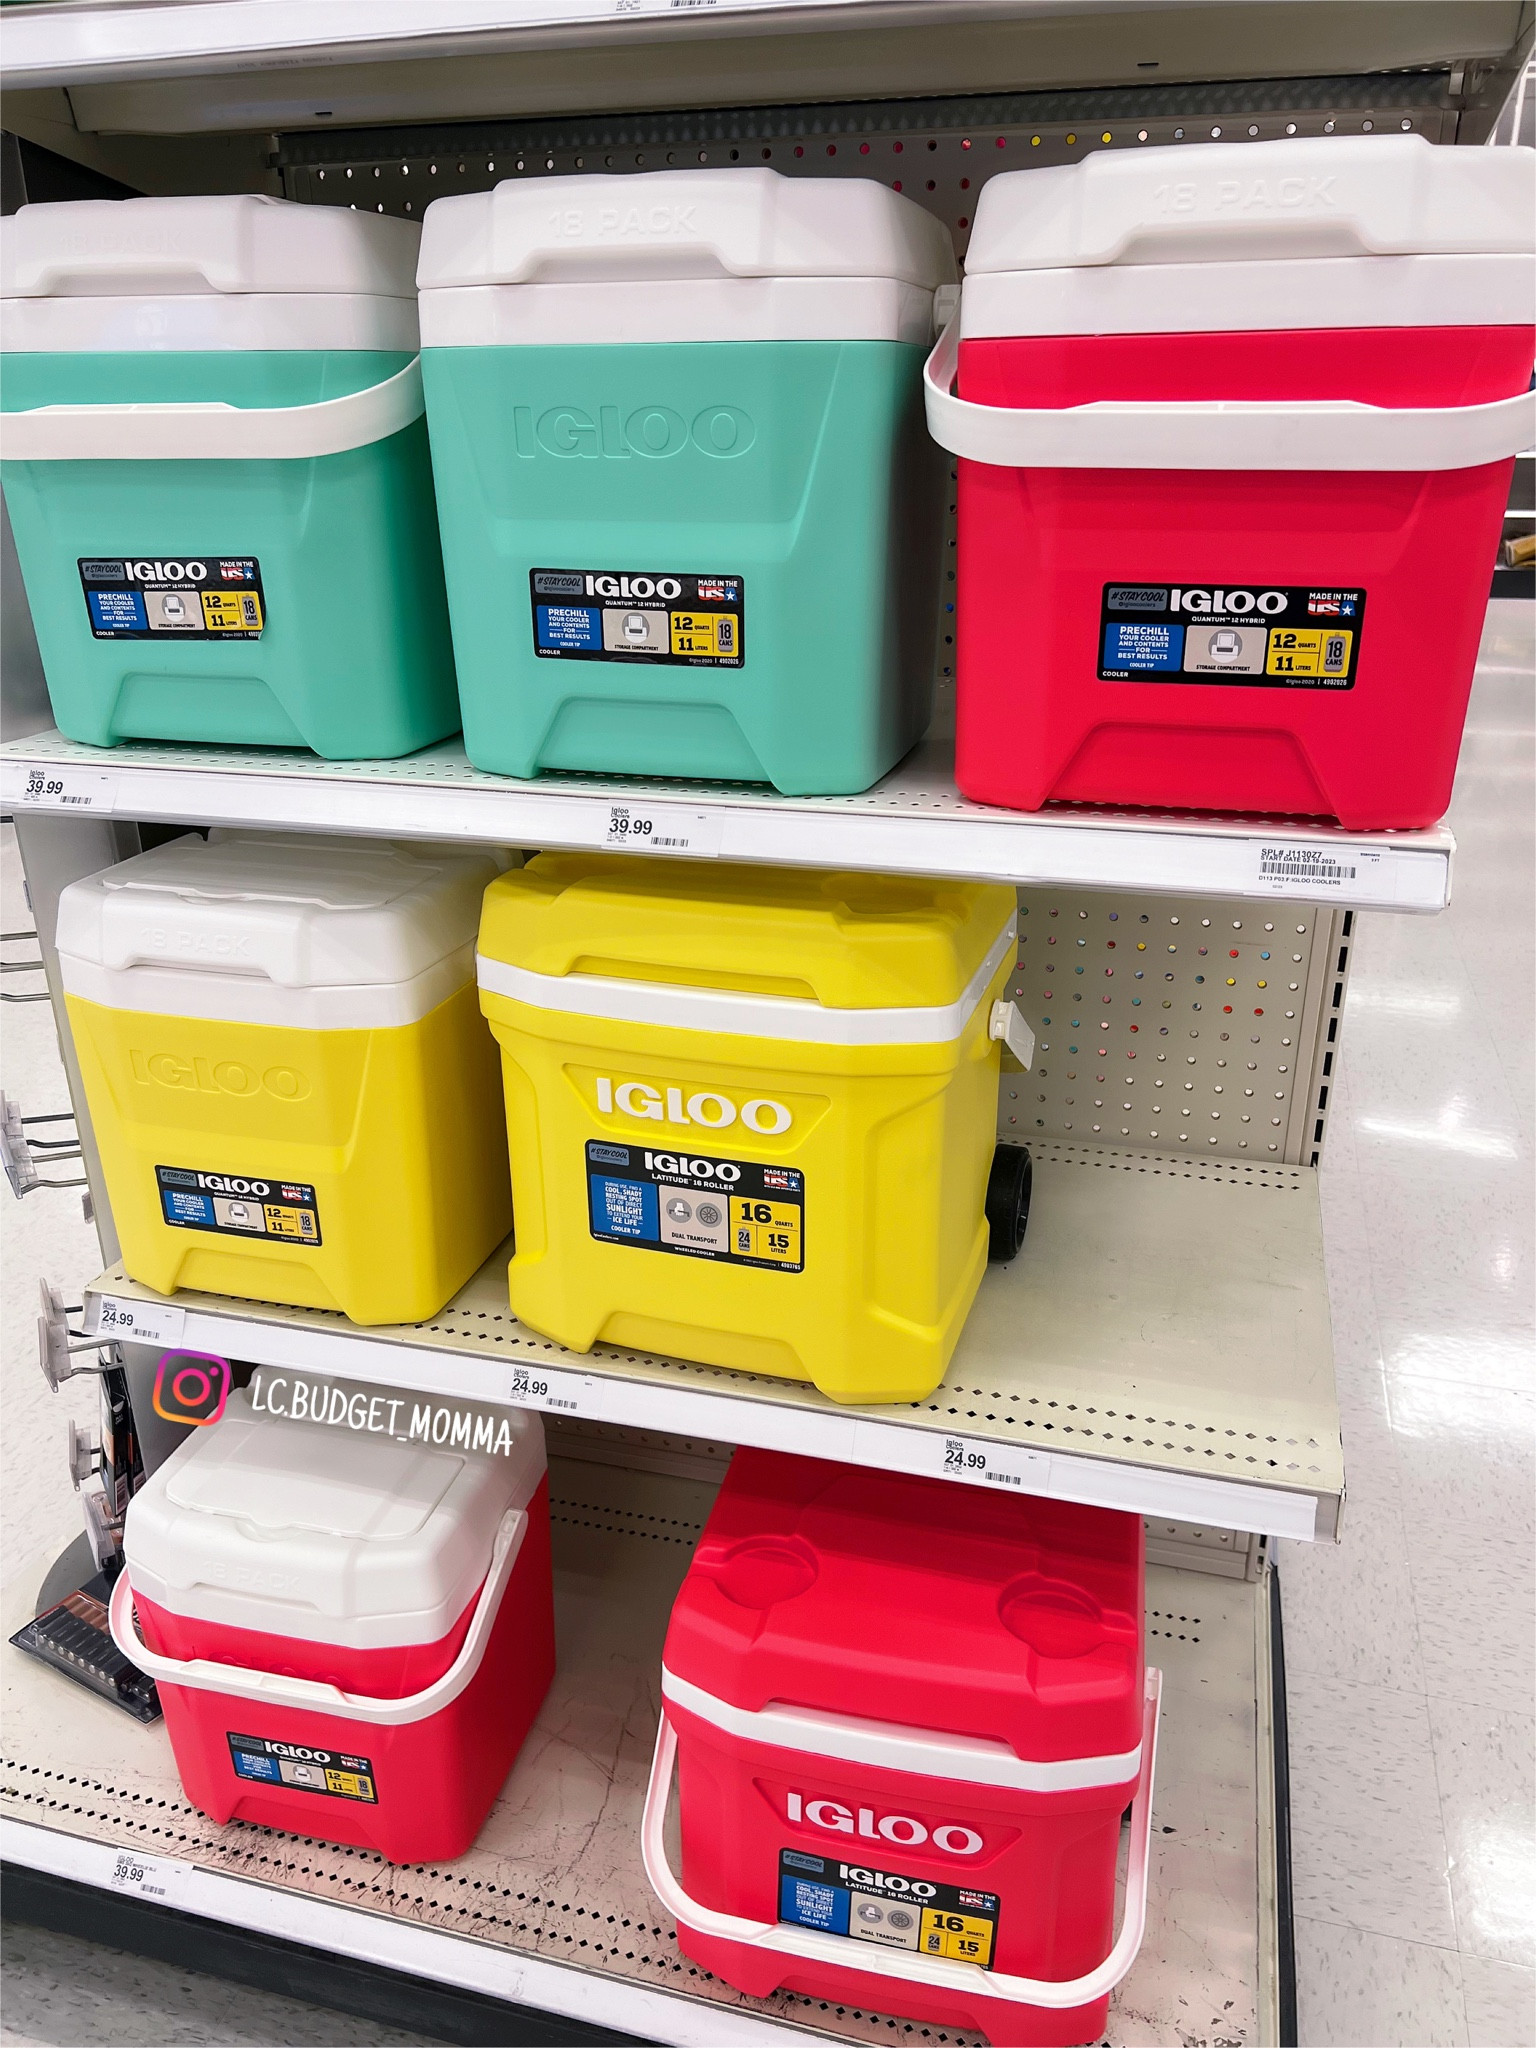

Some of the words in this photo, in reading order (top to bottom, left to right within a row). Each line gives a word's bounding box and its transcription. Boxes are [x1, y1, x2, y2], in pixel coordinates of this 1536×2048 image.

[1214, 175, 1337, 212] PACK
[598, 205, 697, 236] PACK
[513, 405, 757, 459] IGLOO
[125, 561, 207, 581] IGLOO
[220, 567, 255, 581] USA
[537, 576, 581, 586] #STAYCOOL
[585, 575, 682, 599] IGLOO
[698, 586, 737, 602] USA
[1111, 591, 1165, 602] #STAYCOOL
[205, 596, 222, 608] 12
[244, 600, 255, 614] 18
[1170, 589, 1288, 615] IGLOO
[1308, 600, 1356, 616] USA
[548, 608, 589, 617] PRECHILL
[211, 615, 225, 626] 11
[674, 616, 693, 630] 12
[719, 624, 731, 639] 18
[1120, 626, 1169, 635] PRECHILL
[678, 637, 694, 651] 11
[1273, 633, 1297, 649] 12
[1328, 641, 1343, 658] 18
[1275, 656, 1294, 671] 11
[26, 779, 63, 794] 39.99
[609, 818, 652, 835] 39.99
[1261, 848, 1284, 857] SPL#
[129, 1049, 313, 1102] IGLOO
[596, 1077, 792, 1135] IGLOO
[644, 1151, 741, 1182] IGLOO
[763, 1168, 780, 1176] MADE
[789, 1171, 801, 1179] THE
[197, 1173, 270, 1196] IGLOO
[703, 1181, 734, 1191] ROLLER
[764, 1174, 800, 1190] USA
[623, 1189, 642, 1197] SHADY
[267, 1207, 281, 1218] 12
[606, 1203, 643, 1216] SUNLIGHT
[741, 1202, 772, 1224] 16
[272, 1222, 284, 1231] 11
[301, 1215, 310, 1226] 18
[612, 1216, 622, 1224] ICE
[624, 1218, 637, 1226] LIFE
[611, 1225, 631, 1233] COOLER
[671, 1231, 685, 1240] DUAL
[686, 1234, 717, 1244] TRANSPORT
[738, 1231, 750, 1243] 24
[768, 1233, 789, 1248] 15
[102, 1310, 134, 1326] 24.99
[511, 1378, 548, 1396] 24.99
[944, 1449, 986, 1469] 24.99
[265, 1741, 331, 1763] IGLOO
[328, 1771, 341, 1781] 12
[332, 1783, 344, 1791] 11
[787, 1792, 983, 1855] IGLOO
[113, 1864, 144, 1882] 39.99
[839, 1864, 937, 1897] IGLOO
[796, 1898, 833, 1913] SUNLIGHT
[897, 1893, 929, 1904] ROLLER
[799, 1916, 819, 1925] COOLER
[813, 1912, 826, 1920] LIFE
[933, 1914, 964, 1932] 16
[875, 1932, 907, 1943] TRANSPORT
[928, 1935, 940, 1945] 24
[958, 1940, 979, 1953] 15
